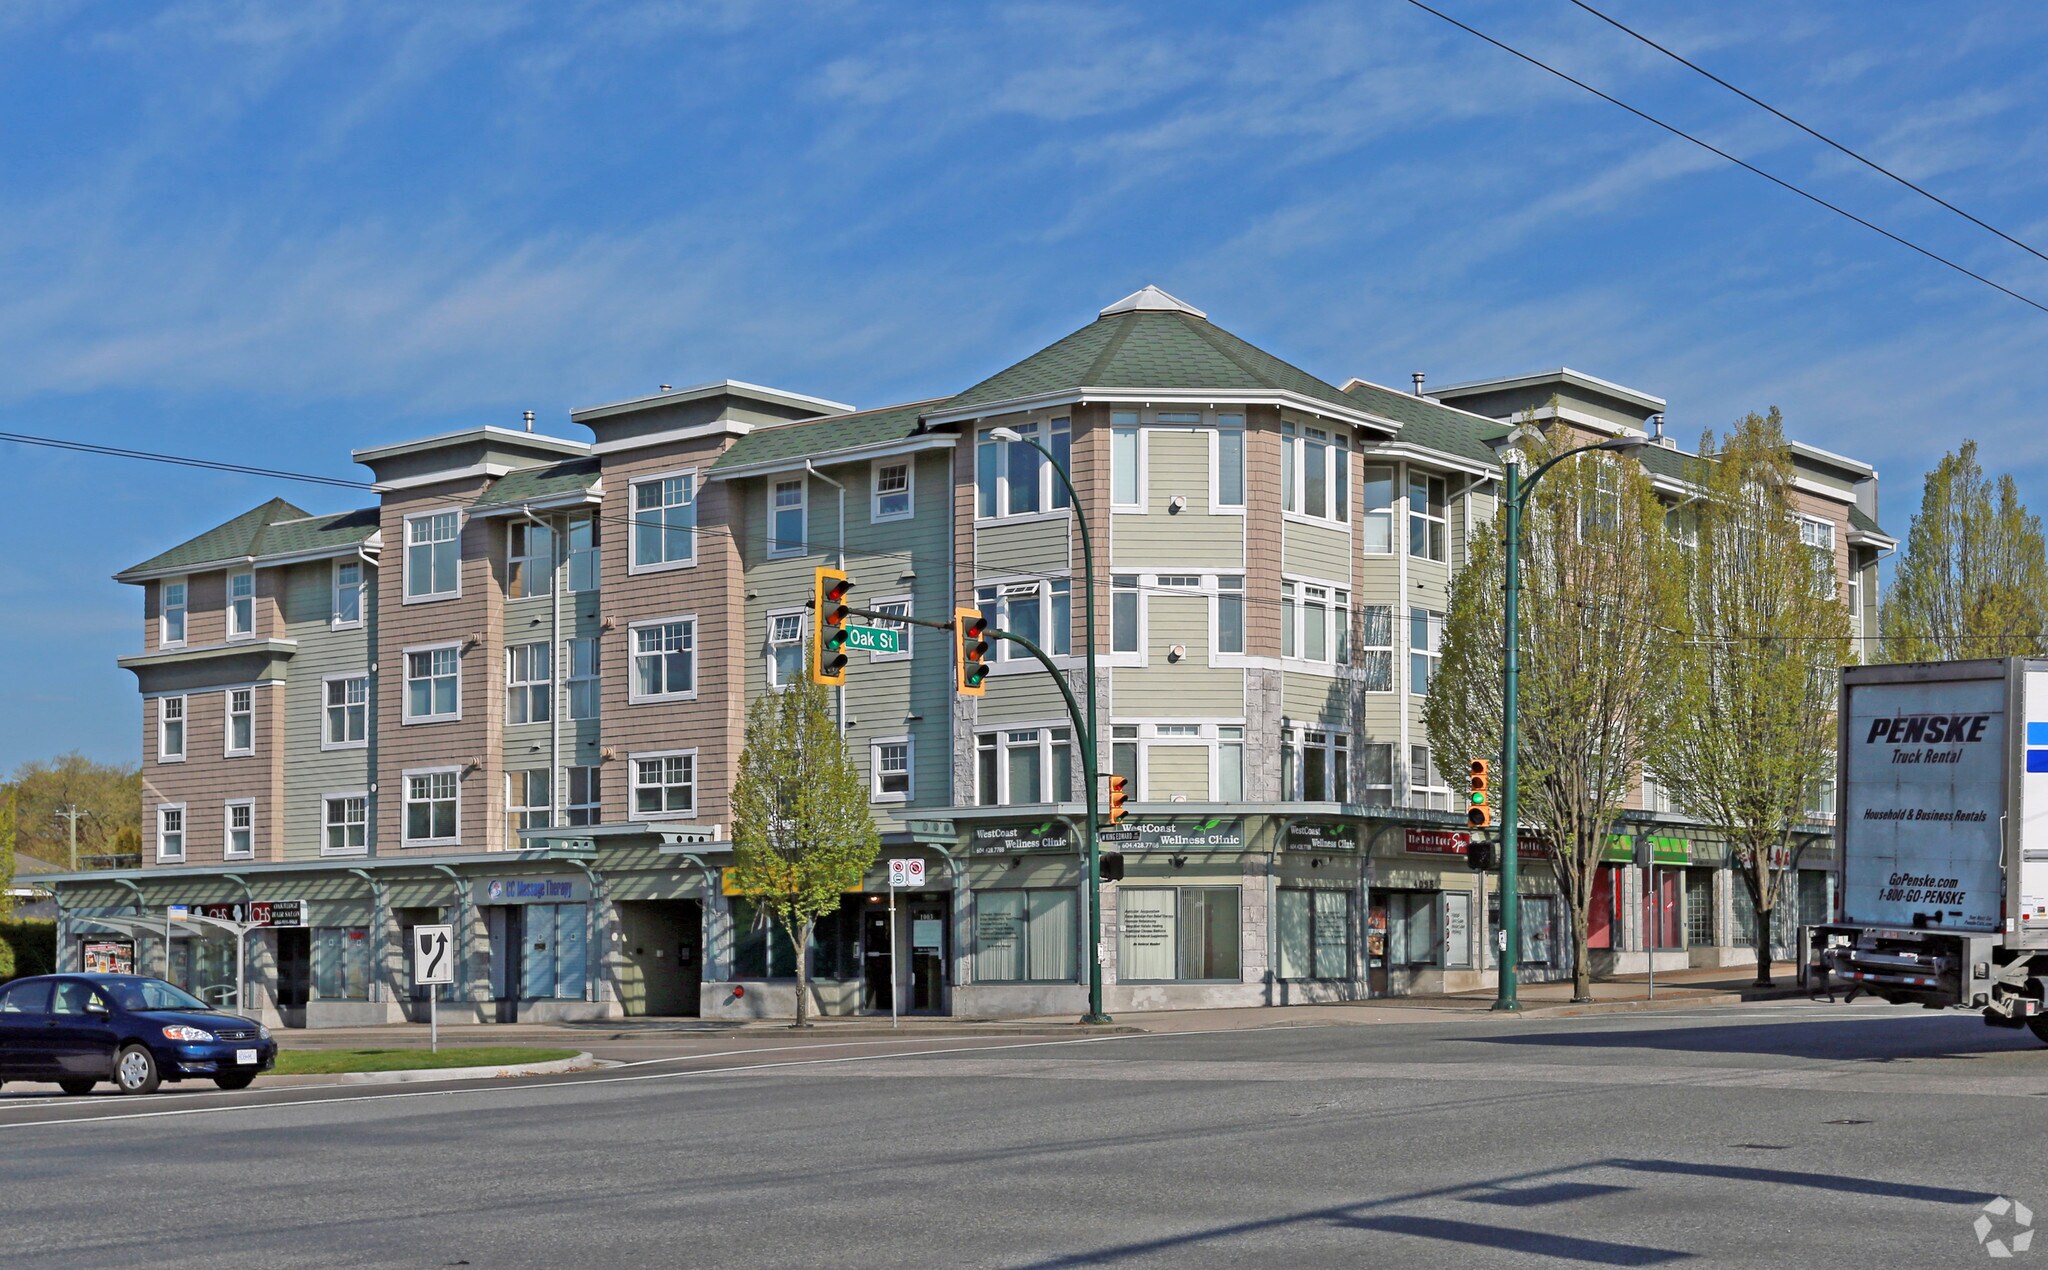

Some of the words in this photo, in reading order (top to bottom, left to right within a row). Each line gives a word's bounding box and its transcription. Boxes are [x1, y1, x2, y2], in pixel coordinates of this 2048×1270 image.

[850, 629, 874, 646] Oak
[880, 633, 893, 648] St
[1866, 716, 1990, 744] PENSKE
[1892, 749, 1922, 763] Truck
[1924, 749, 1962, 763] Rental
[1864, 809, 1906, 820] Household
[1906, 809, 1914, 820] &
[1916, 810, 1953, 820] Business
[1954, 810, 1987, 822] Rentals
[976, 829, 1018, 838] WestCoast
[1122, 824, 1176, 832] WestCoast
[1290, 826, 1320, 835] WestCoast
[1005, 840, 1040, 848] Wellness
[1042, 838, 1066, 847] Clinic
[1160, 836, 1205, 844] Wellness
[1208, 836, 1240, 844] Clinic
[1312, 838, 1336, 848] Wellness
[1338, 840, 1356, 848] Clinic
[1452, 832, 1467, 852] Spa
[1890, 873, 1958, 888] GoPenske.com
[546, 880, 572, 898] Therapy
[1879, 888, 1966, 904] 1-800-GO-PENSKE
